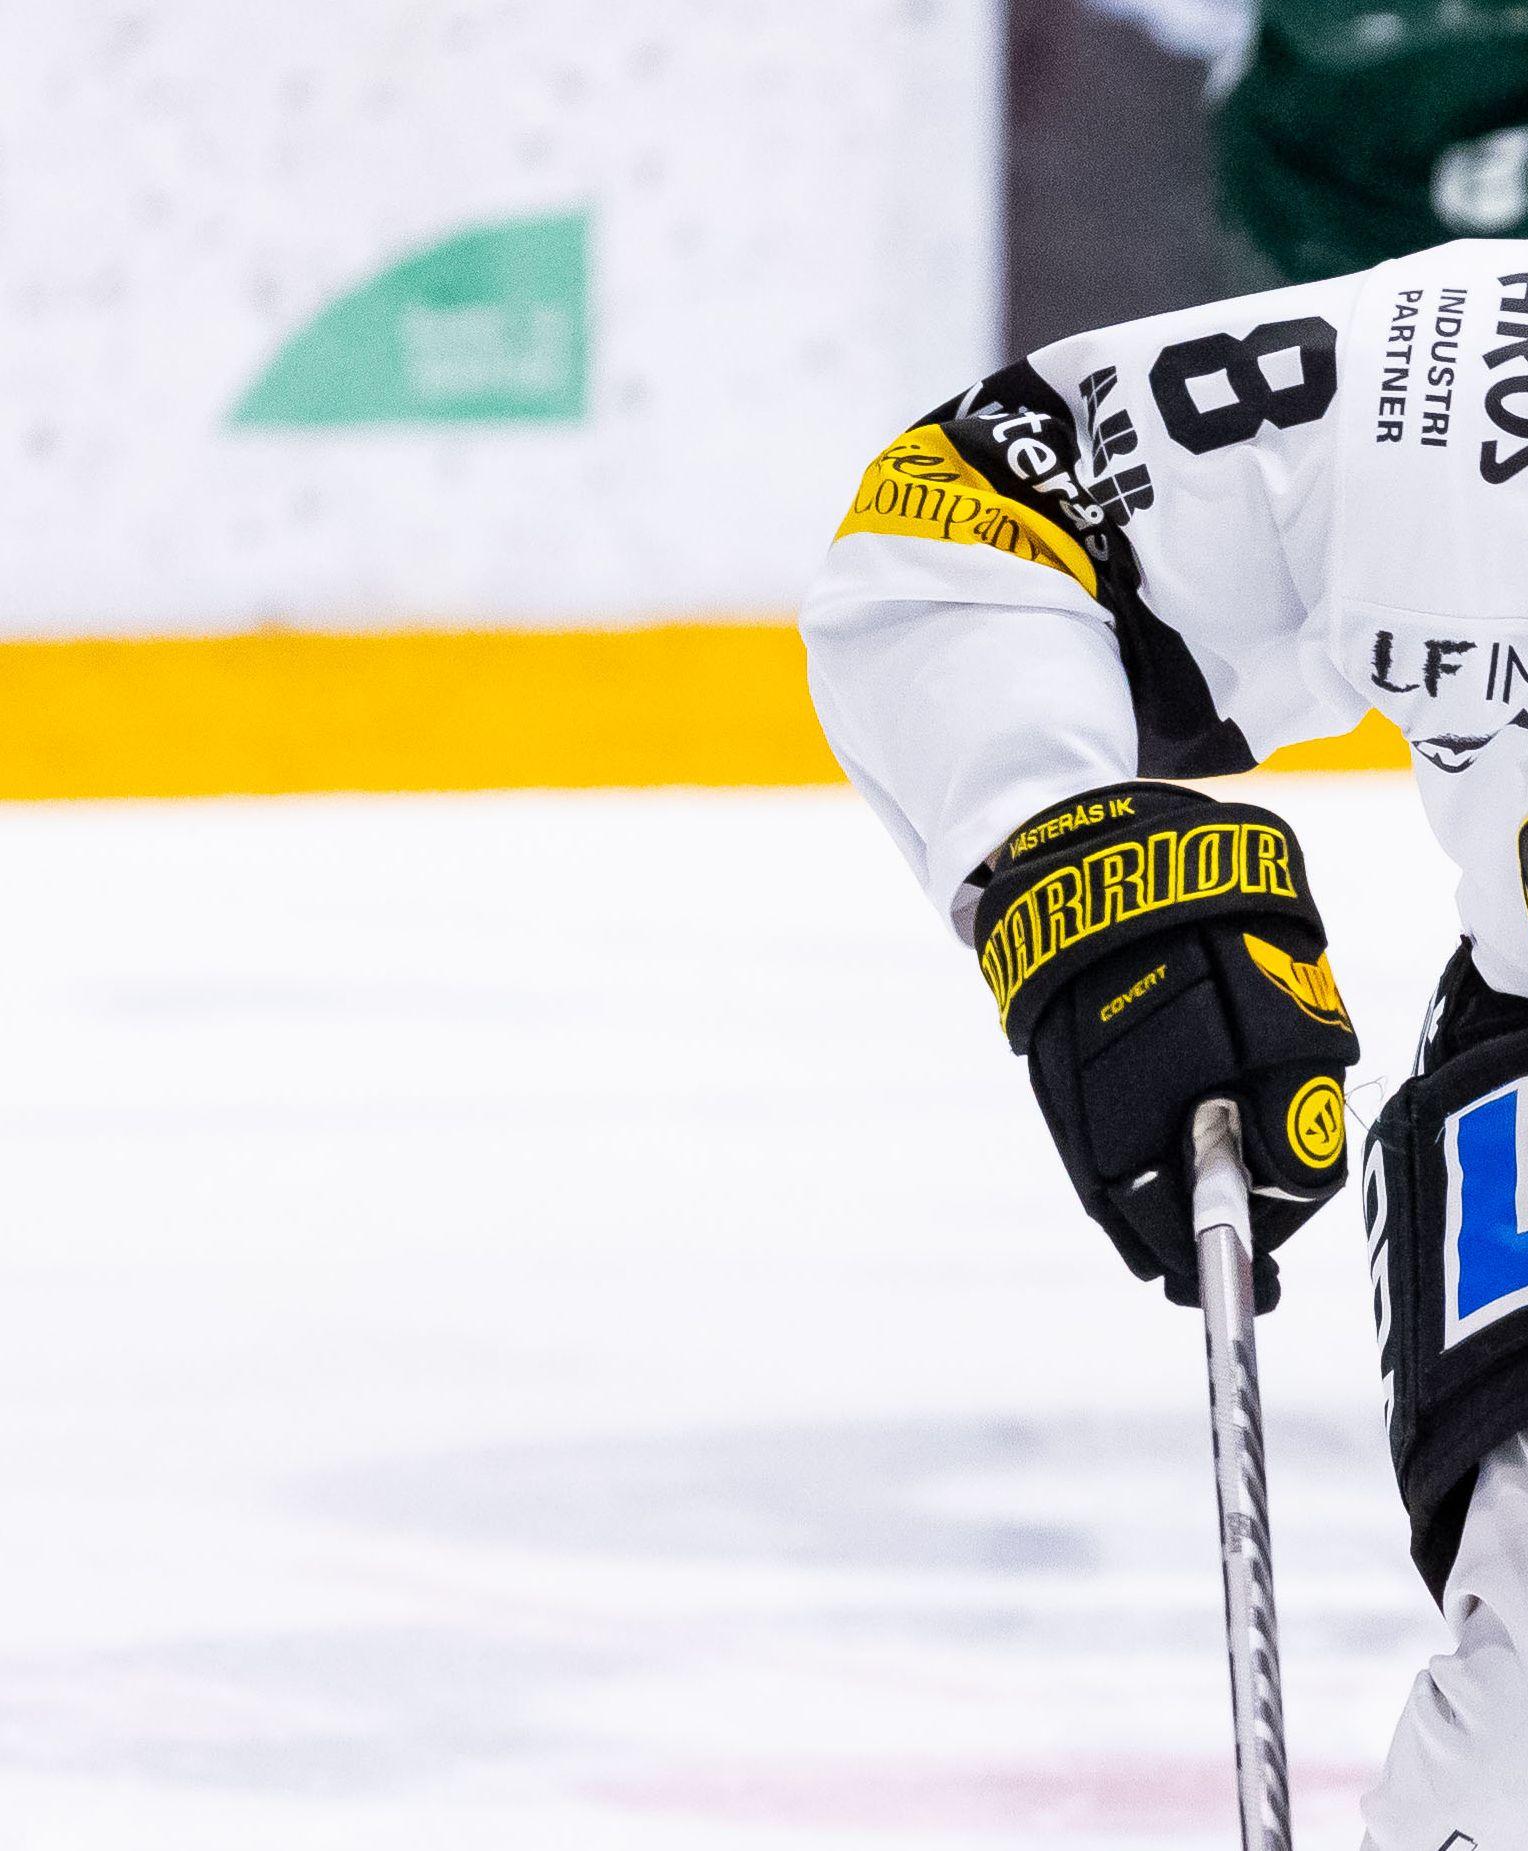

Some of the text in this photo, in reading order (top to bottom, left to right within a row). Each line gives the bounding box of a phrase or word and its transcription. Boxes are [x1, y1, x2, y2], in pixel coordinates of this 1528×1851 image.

[1148, 316, 1338, 456] 8
[1376, 289, 1424, 444] PARTNER
[1420, 288, 1468, 448] INDUSTRI
[1370, 629, 1478, 698] LF
[1108, 797, 1136, 818] IK
[1100, 964, 1167, 1022] COVERT
